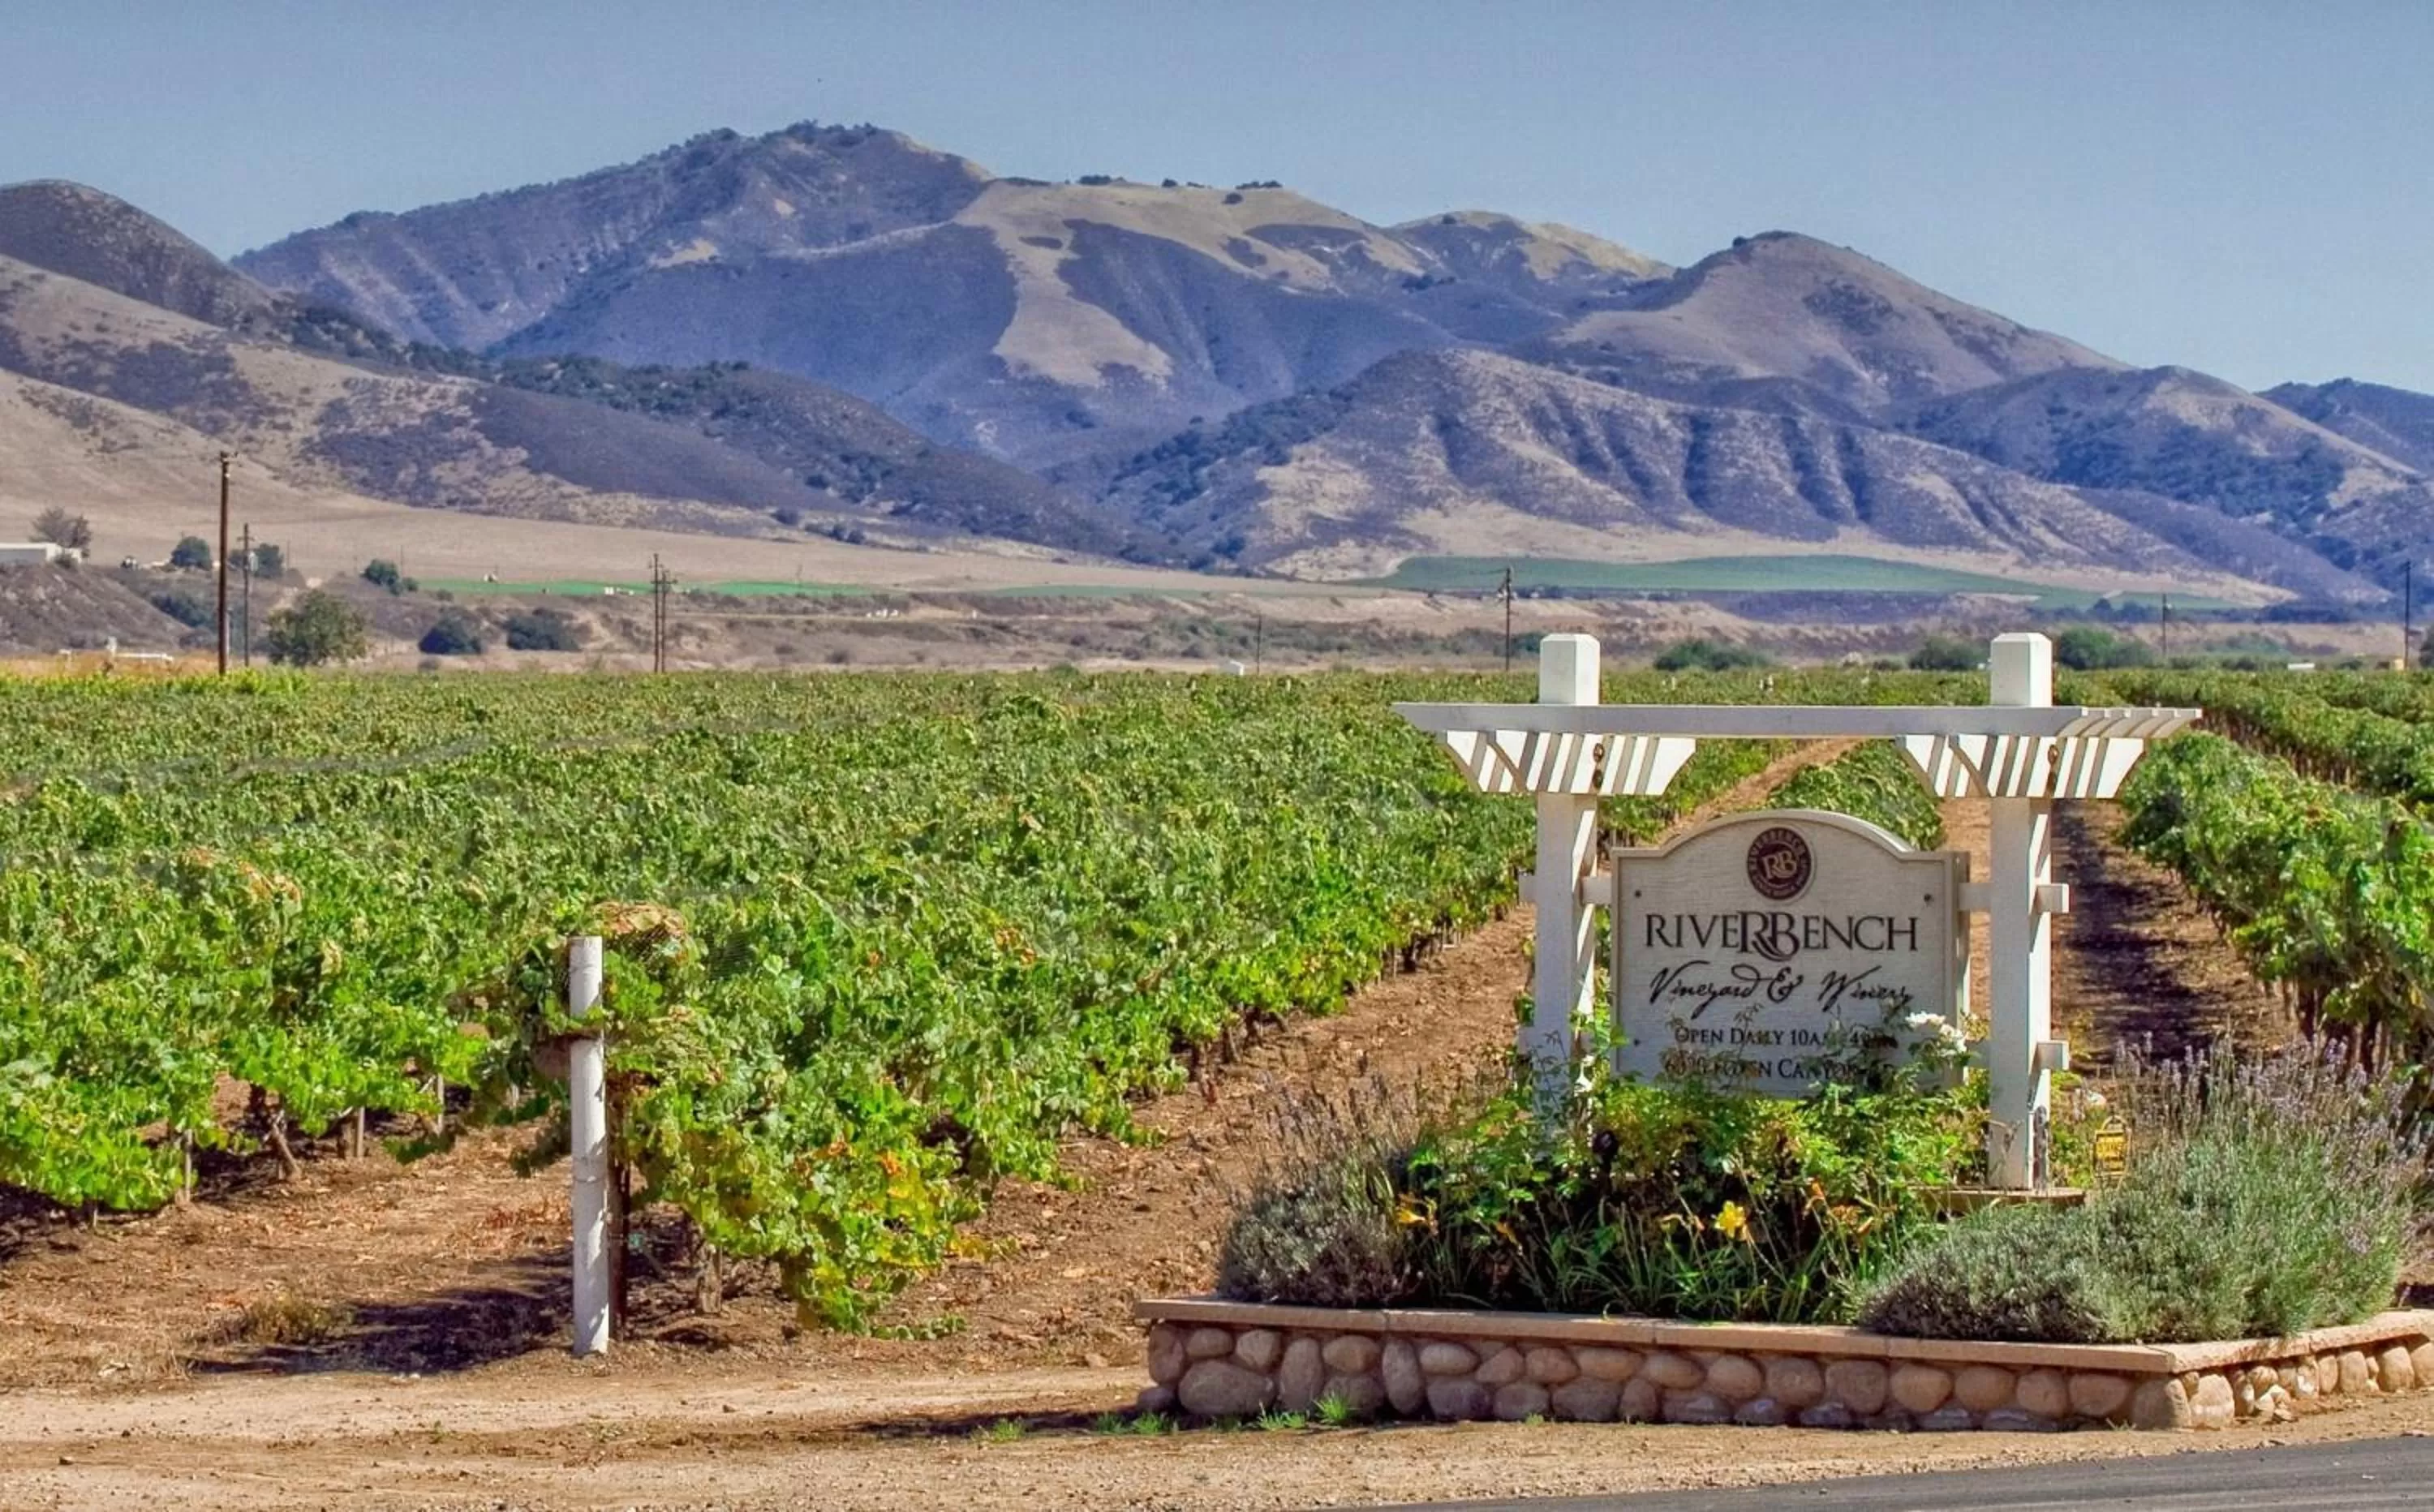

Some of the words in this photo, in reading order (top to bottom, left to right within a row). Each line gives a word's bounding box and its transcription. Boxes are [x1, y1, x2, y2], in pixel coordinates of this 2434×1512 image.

[1645, 911, 1920, 962] RIVERBENCH
[1649, 960, 1762, 1020] Vineyard
[1766, 966, 1804, 1003] &
[1817, 964, 1914, 1020] Winery
